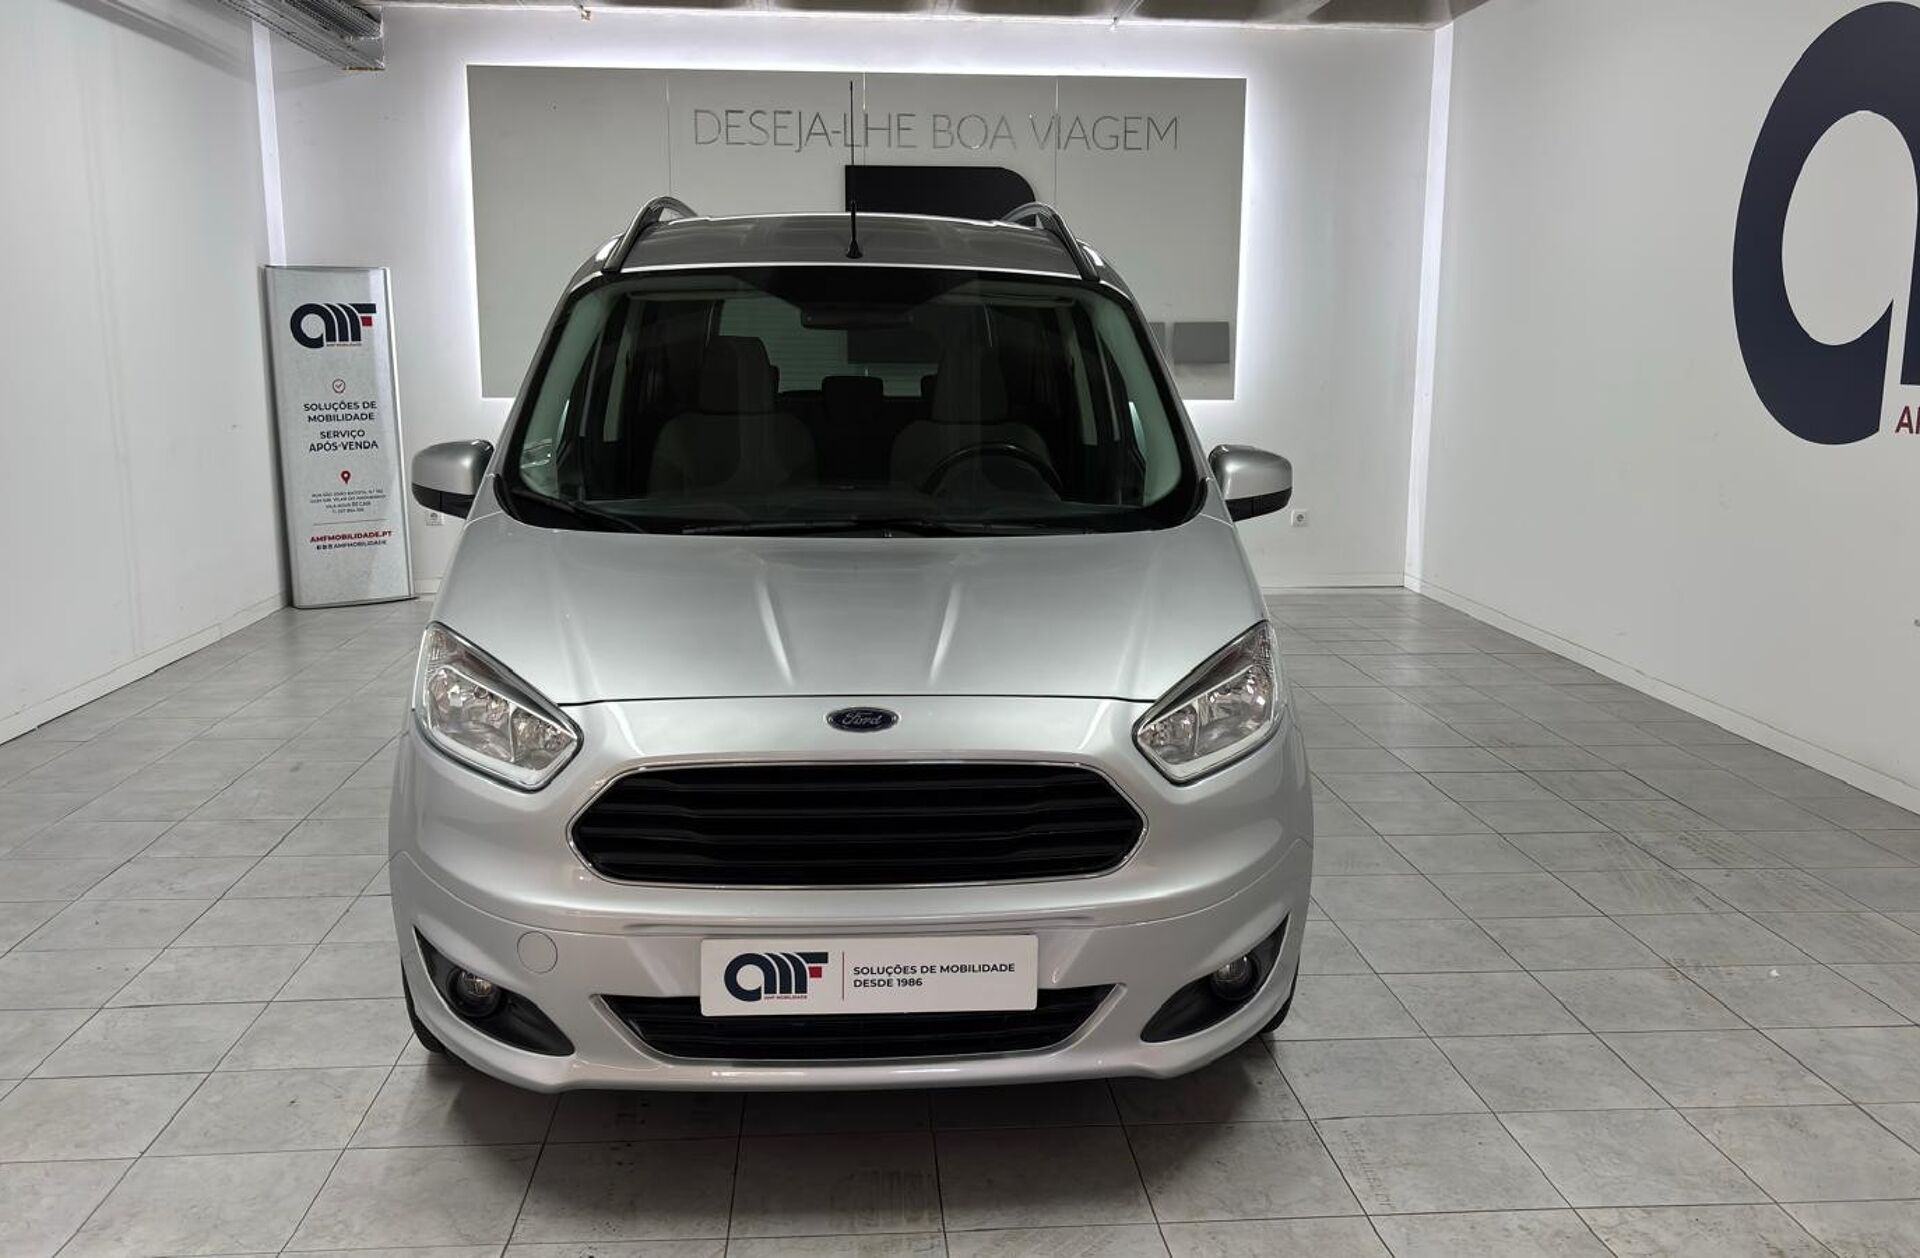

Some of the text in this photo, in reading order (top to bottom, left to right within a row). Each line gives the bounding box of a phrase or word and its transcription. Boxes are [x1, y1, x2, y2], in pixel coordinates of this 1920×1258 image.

[694, 109, 1178, 152] DESEJA-LHE BOA VIAGEM
[303, 401, 377, 412] SOLUÇÕES DE
[308, 412, 375, 423] MOBILIDADE
[320, 429, 366, 440] SERVIÇO
[309, 440, 379, 452] APÓS-VENDA
[842, 712, 883, 726] Ford
[853, 963, 1016, 977] SOLUÇÕES DE MOBILIDADE
[853, 978, 923, 988] DESDE 1986
